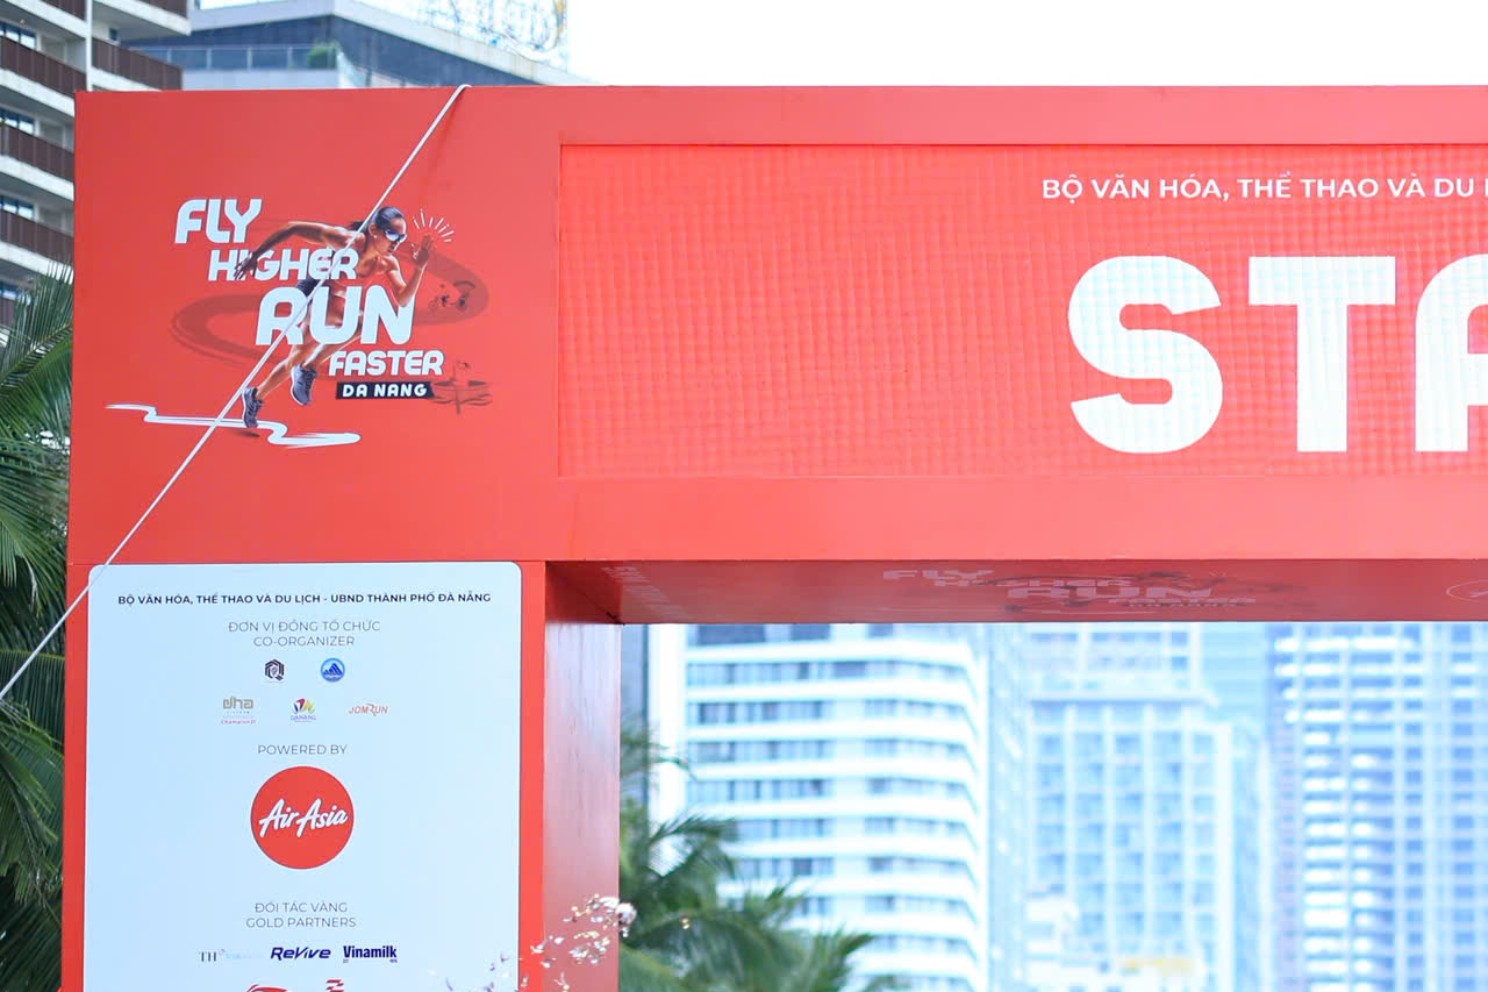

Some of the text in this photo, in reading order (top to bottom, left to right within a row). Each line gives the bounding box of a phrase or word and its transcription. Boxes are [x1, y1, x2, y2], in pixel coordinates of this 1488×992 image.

[1042, 174, 1083, 202] BỘ
[1092, 173, 1150, 199] VĂN
[1160, 173, 1230, 201] HÓA,
[1238, 170, 1291, 198] THỂ
[1300, 177, 1379, 198] THAO
[1388, 173, 1425, 198] VÀ
[1434, 177, 1475, 197] DU
[174, 198, 263, 244] FLY
[208, 248, 360, 282] HIGHER
[255, 285, 416, 346] RUN
[329, 350, 445, 377] FASTER
[342, 382, 428, 398] DA NANG
[223, 594, 252, 604] THAO
[256, 592, 272, 603] VÀ
[275, 594, 292, 603] DU
[295, 593, 321, 605] LỊCH
[331, 594, 364, 603] UBND
[367, 591, 407, 602] THÀNH
[438, 591, 455, 602] ĐÀ
[253, 636, 355, 647] CO-ORGANIZER
[257, 745, 348, 755] POWERED BY
[246, 917, 357, 928] GOLD PARTNERS
[343, 945, 398, 958] Vinamilk
